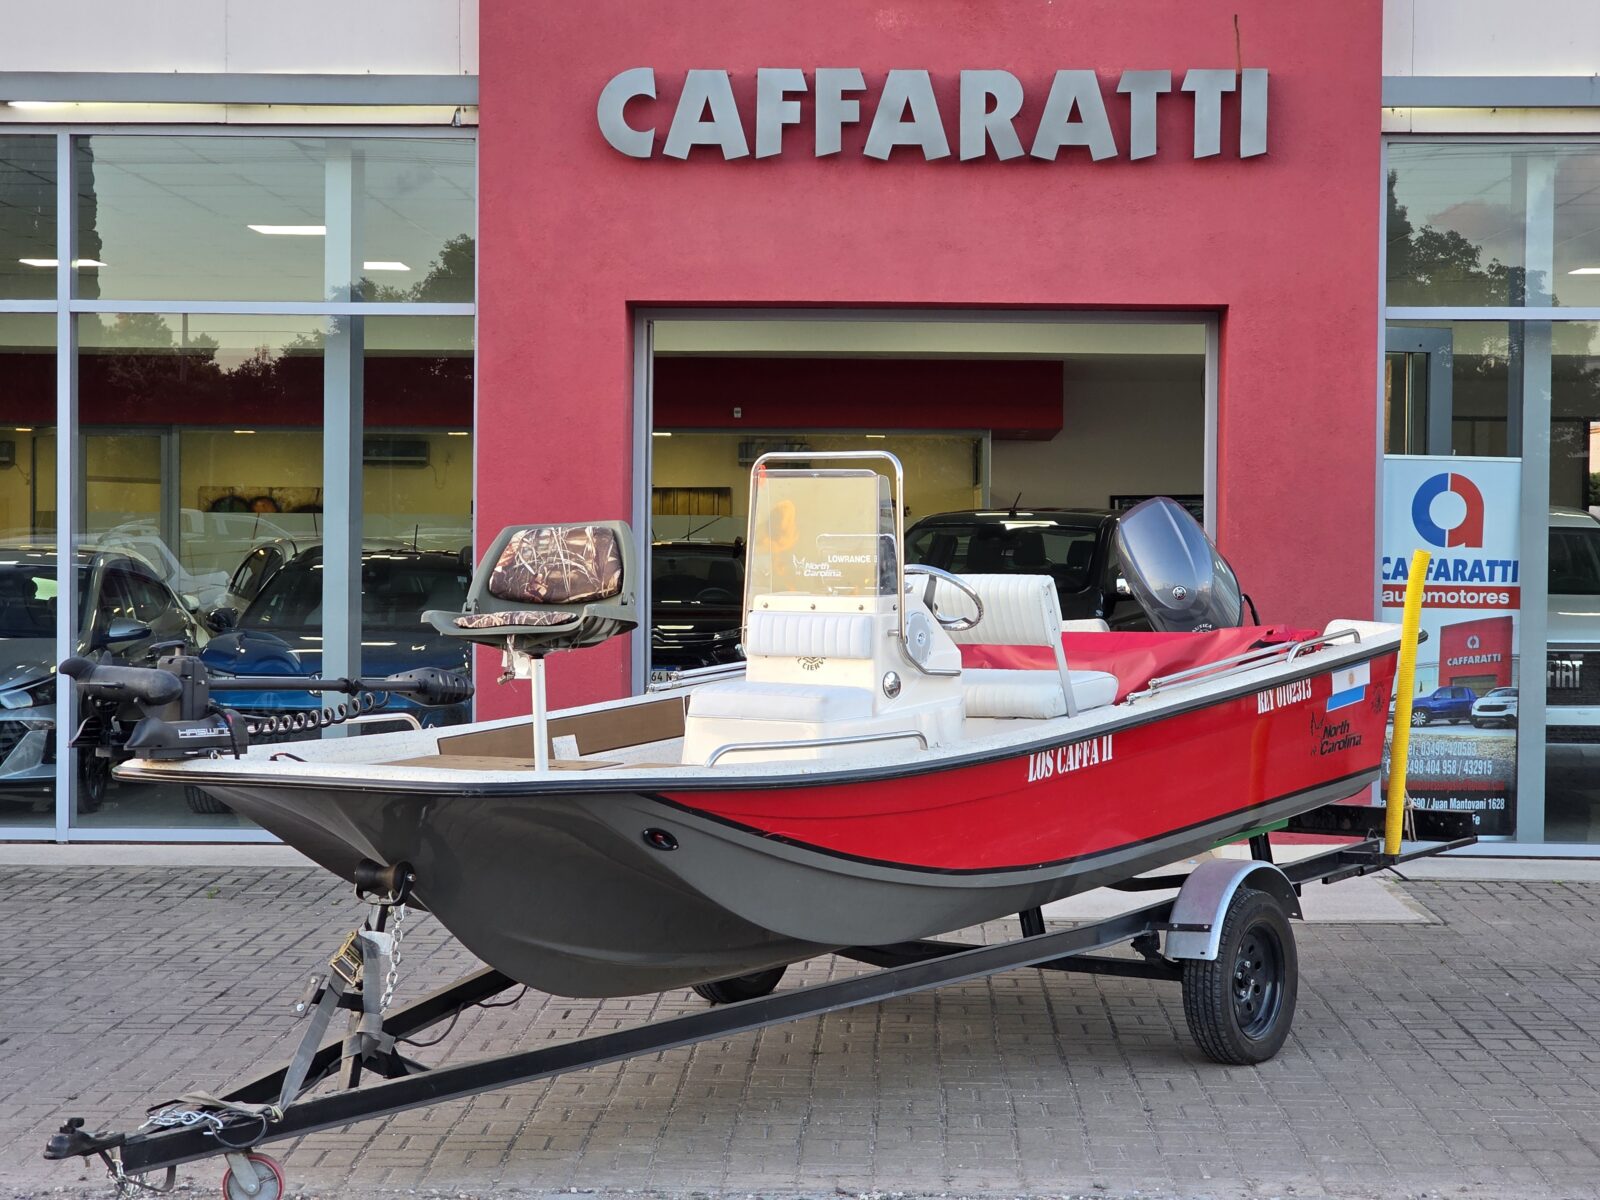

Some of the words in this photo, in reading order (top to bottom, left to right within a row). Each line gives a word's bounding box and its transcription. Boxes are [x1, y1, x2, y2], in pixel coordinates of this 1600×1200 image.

[597, 67, 1269, 161] CAFFARATTI
[805, 562, 830, 570] North
[828, 555, 871, 563] LOWRANCE
[804, 569, 841, 577] Carolina
[1382, 556, 1519, 583] CAFARATTI
[1447, 653, 1502, 666] CAFFARATTI
[651, 671, 663, 682] 64
[1547, 660, 1583, 688] FIAT
[1322, 719, 1350, 739] North
[1320, 734, 1362, 756] Carolina
[1028, 750, 1054, 783] LOS
[1056, 738, 1099, 774] CAFFA
[1102, 734, 1113, 762] II
[1442, 760, 1457, 774] 958
[1463, 760, 1493, 775] 432915
[1431, 799, 1448, 810] Juan
[1449, 798, 1486, 810] Mantovani
[1488, 798, 1505, 810] 1628
